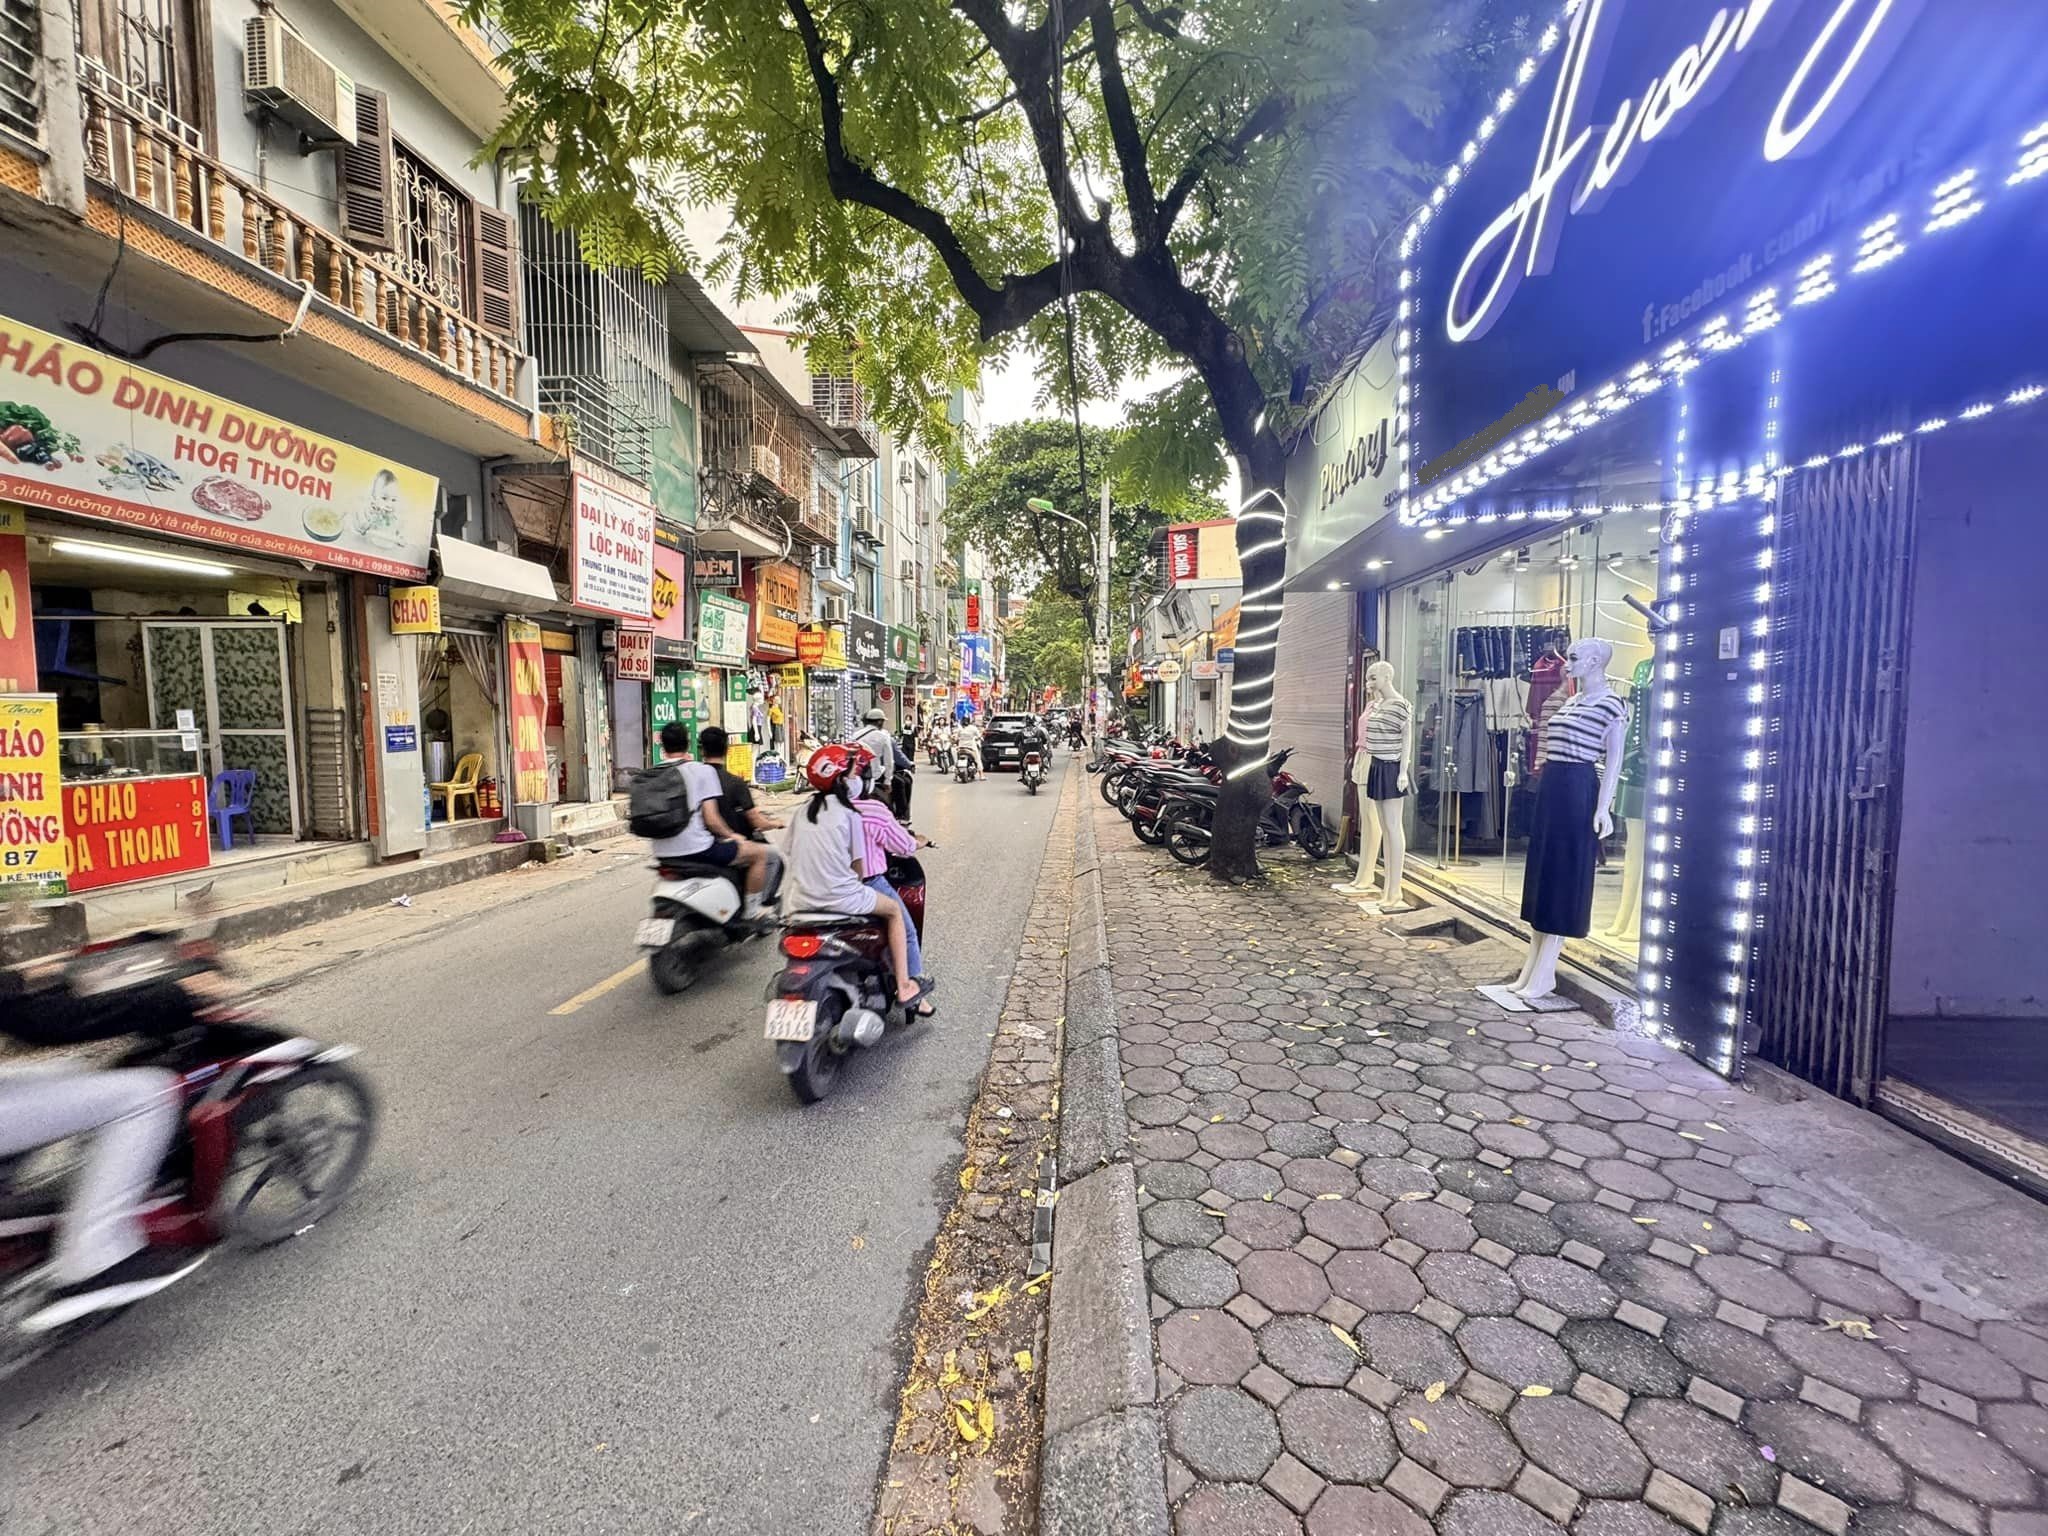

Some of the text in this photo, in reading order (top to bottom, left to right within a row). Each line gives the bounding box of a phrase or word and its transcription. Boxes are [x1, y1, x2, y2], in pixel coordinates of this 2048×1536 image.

[0, 332, 338, 473] HÁO DINH DƯỠNG
[174, 434, 333, 501] HOA THOAN
[13, 484, 52, 501] dinh
[57, 494, 113, 516] dưỡng
[149, 512, 163, 526] lý
[165, 516, 178, 528] là
[580, 502, 601, 526] ĐẠI
[604, 510, 617, 531] LÝ
[620, 516, 634, 537] XỔ
[637, 519, 650, 544] SỐ
[589, 531, 644, 568] LỘC PHÁT
[1173, 534, 1193, 553] SỬA
[581, 557, 602, 572] TRUNG
[617, 567, 628, 579] TRẢ
[392, 592, 428, 625] CHÁO
[620, 633, 650, 653] ĐẠI LÝ
[620, 653, 649, 672] XỔ SỐ
[654, 672, 675, 693] RÈM
[654, 697, 677, 721] CỬA
[0, 720, 44, 757] HÁO
[0, 772, 43, 801] INH
[72, 783, 137, 826] CHAO
[0, 807, 60, 846] ỠNG
[64, 823, 181, 876] OA THOAN
